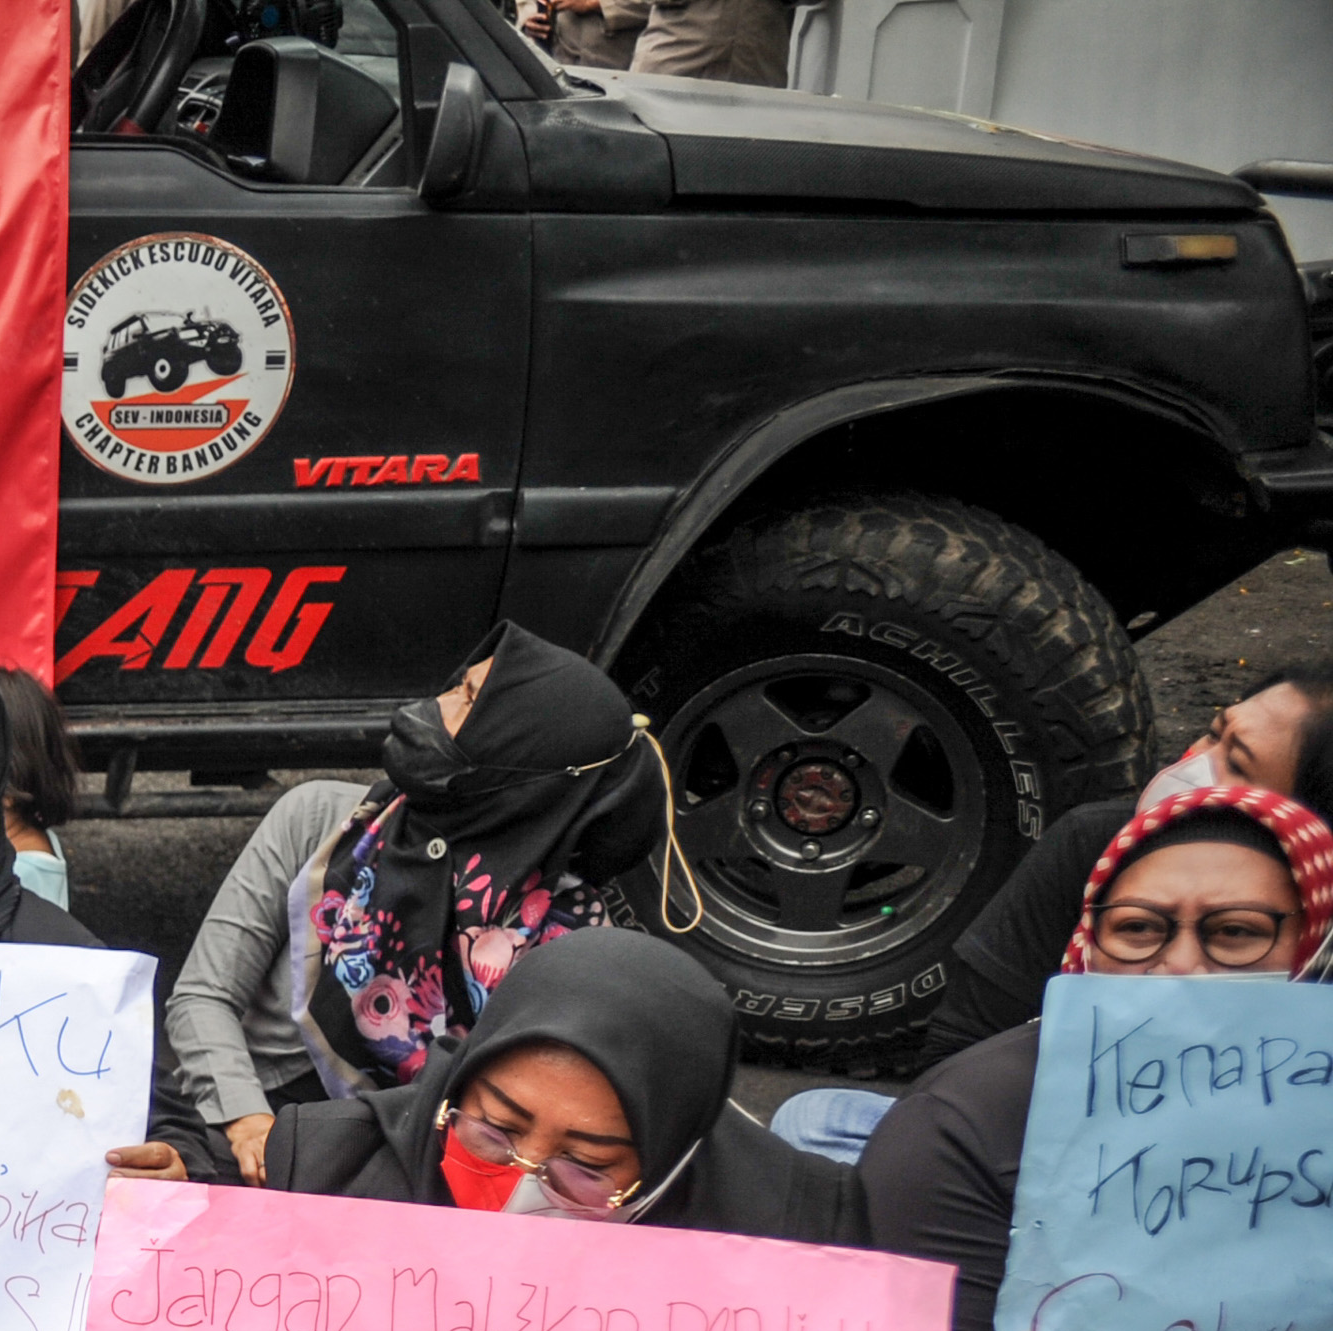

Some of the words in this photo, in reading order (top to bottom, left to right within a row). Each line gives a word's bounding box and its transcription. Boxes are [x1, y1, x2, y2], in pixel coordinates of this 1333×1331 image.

[67, 250, 148, 328] SIDEKICK
[147, 242, 228, 272] ESCUDO
[229, 258, 281, 328] VITARA
[75, 413, 158, 474] CHAPTER
[166, 411, 262, 474] BANDUNG
[115, 409, 139, 424] SEV
[150, 408, 223, 424] INDONESIA
[293, 453, 480, 486] VITARA
[820, 611, 1042, 840] ACHILLES
[721, 962, 948, 1022] DESER
